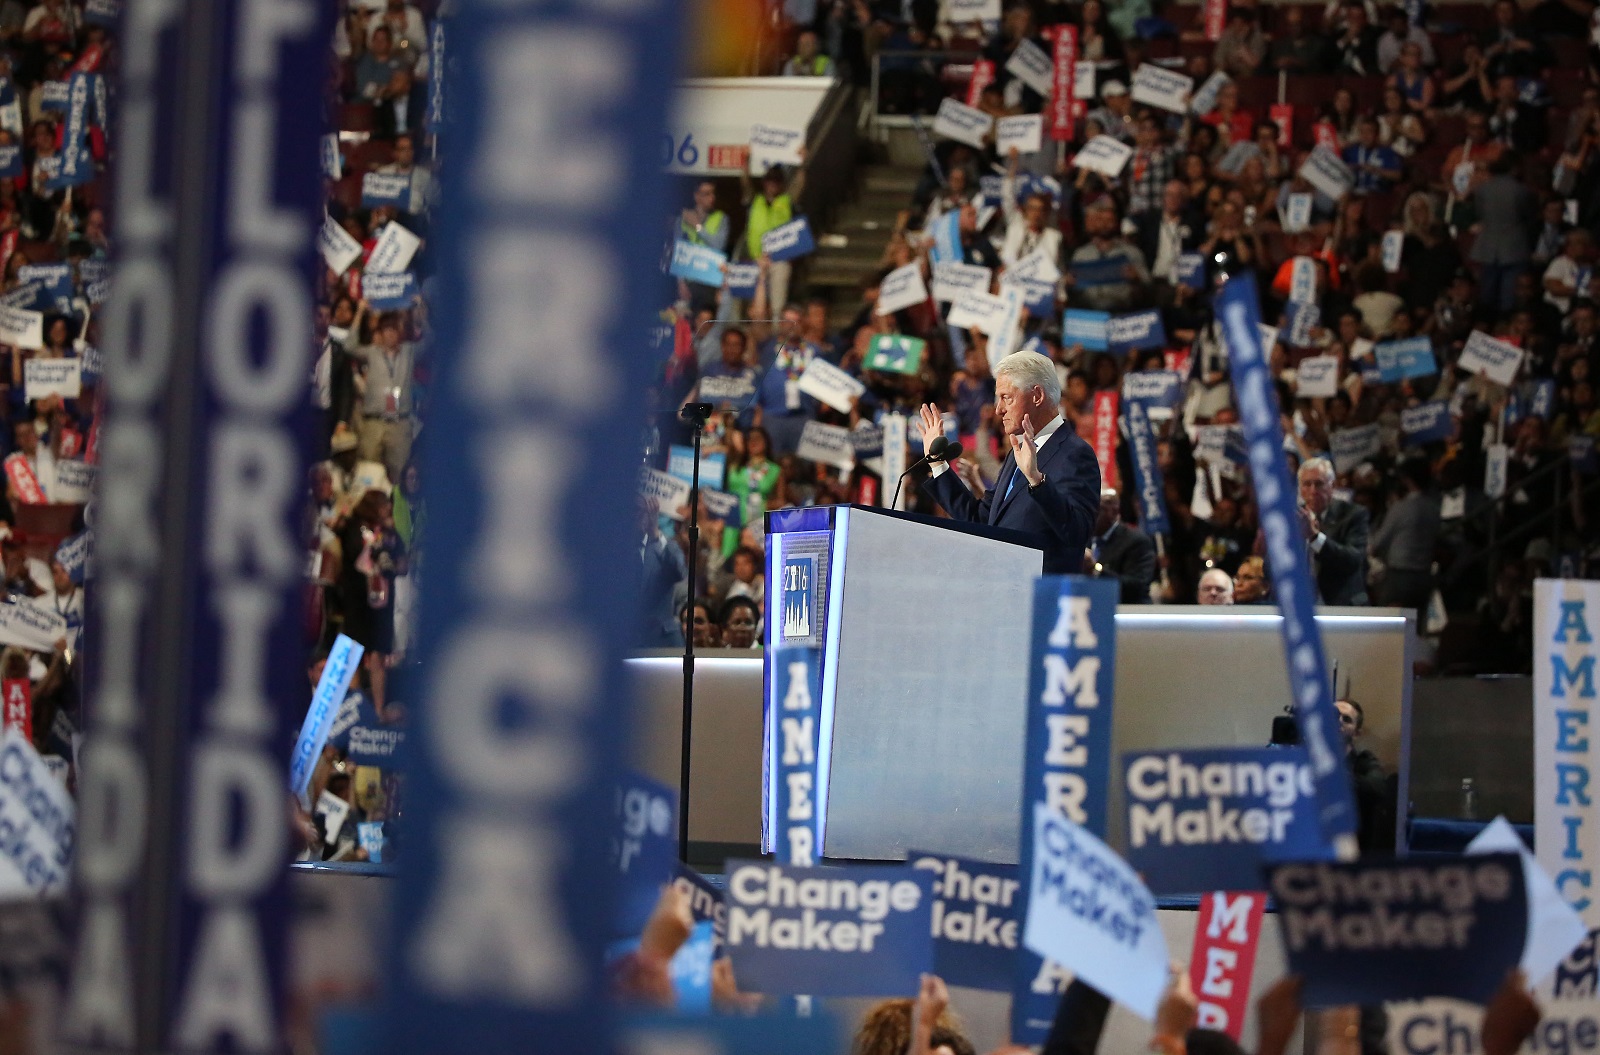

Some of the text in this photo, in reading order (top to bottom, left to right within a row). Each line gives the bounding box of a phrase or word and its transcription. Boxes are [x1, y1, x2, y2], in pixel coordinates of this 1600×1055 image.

[1549, 599, 1597, 912] AMERIC
[1129, 797, 1295, 848] Maker
[729, 864, 922, 922] Change
[1272, 860, 1512, 911] Change
[726, 907, 885, 952] Maker
[1287, 902, 1478, 949] Maker
